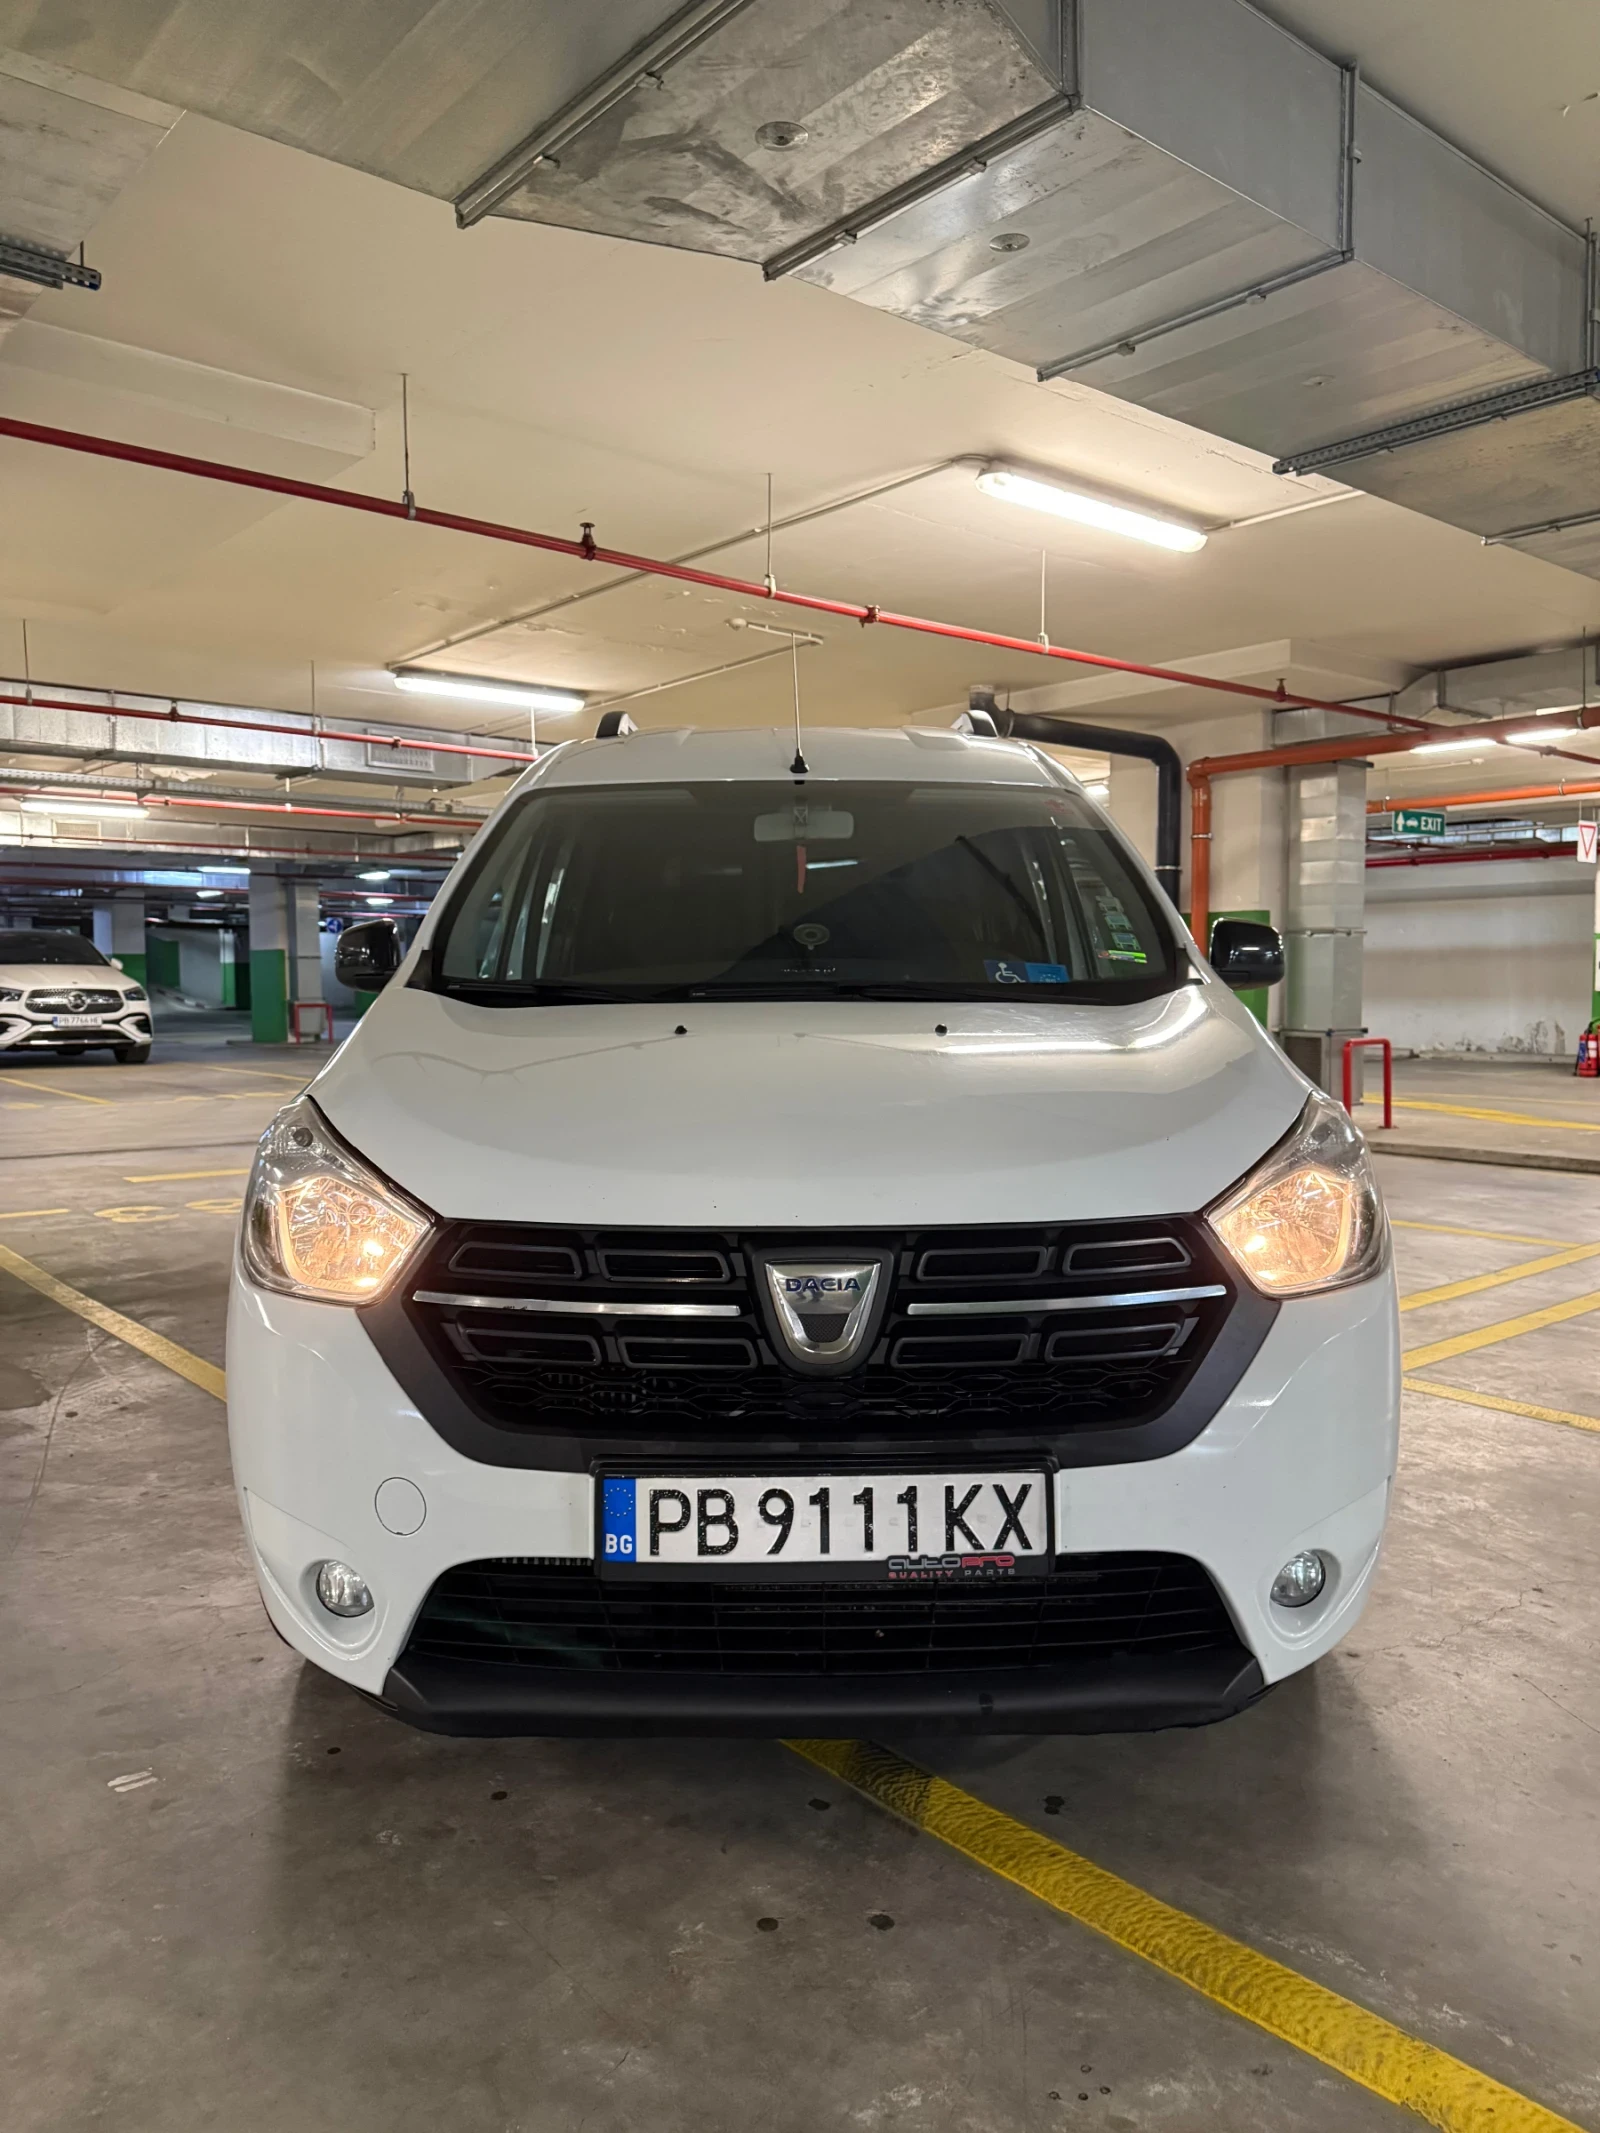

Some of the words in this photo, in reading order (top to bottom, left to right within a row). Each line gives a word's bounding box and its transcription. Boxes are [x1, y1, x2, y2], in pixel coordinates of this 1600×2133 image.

[1421, 816, 1442, 832] EXIT
[785, 1278, 861, 1292] DACIA
[649, 1488, 739, 1556] PB
[605, 1534, 633, 1554] BG
[888, 1569, 954, 1580] QUALITY
[964, 1568, 1016, 1577] PARTS
